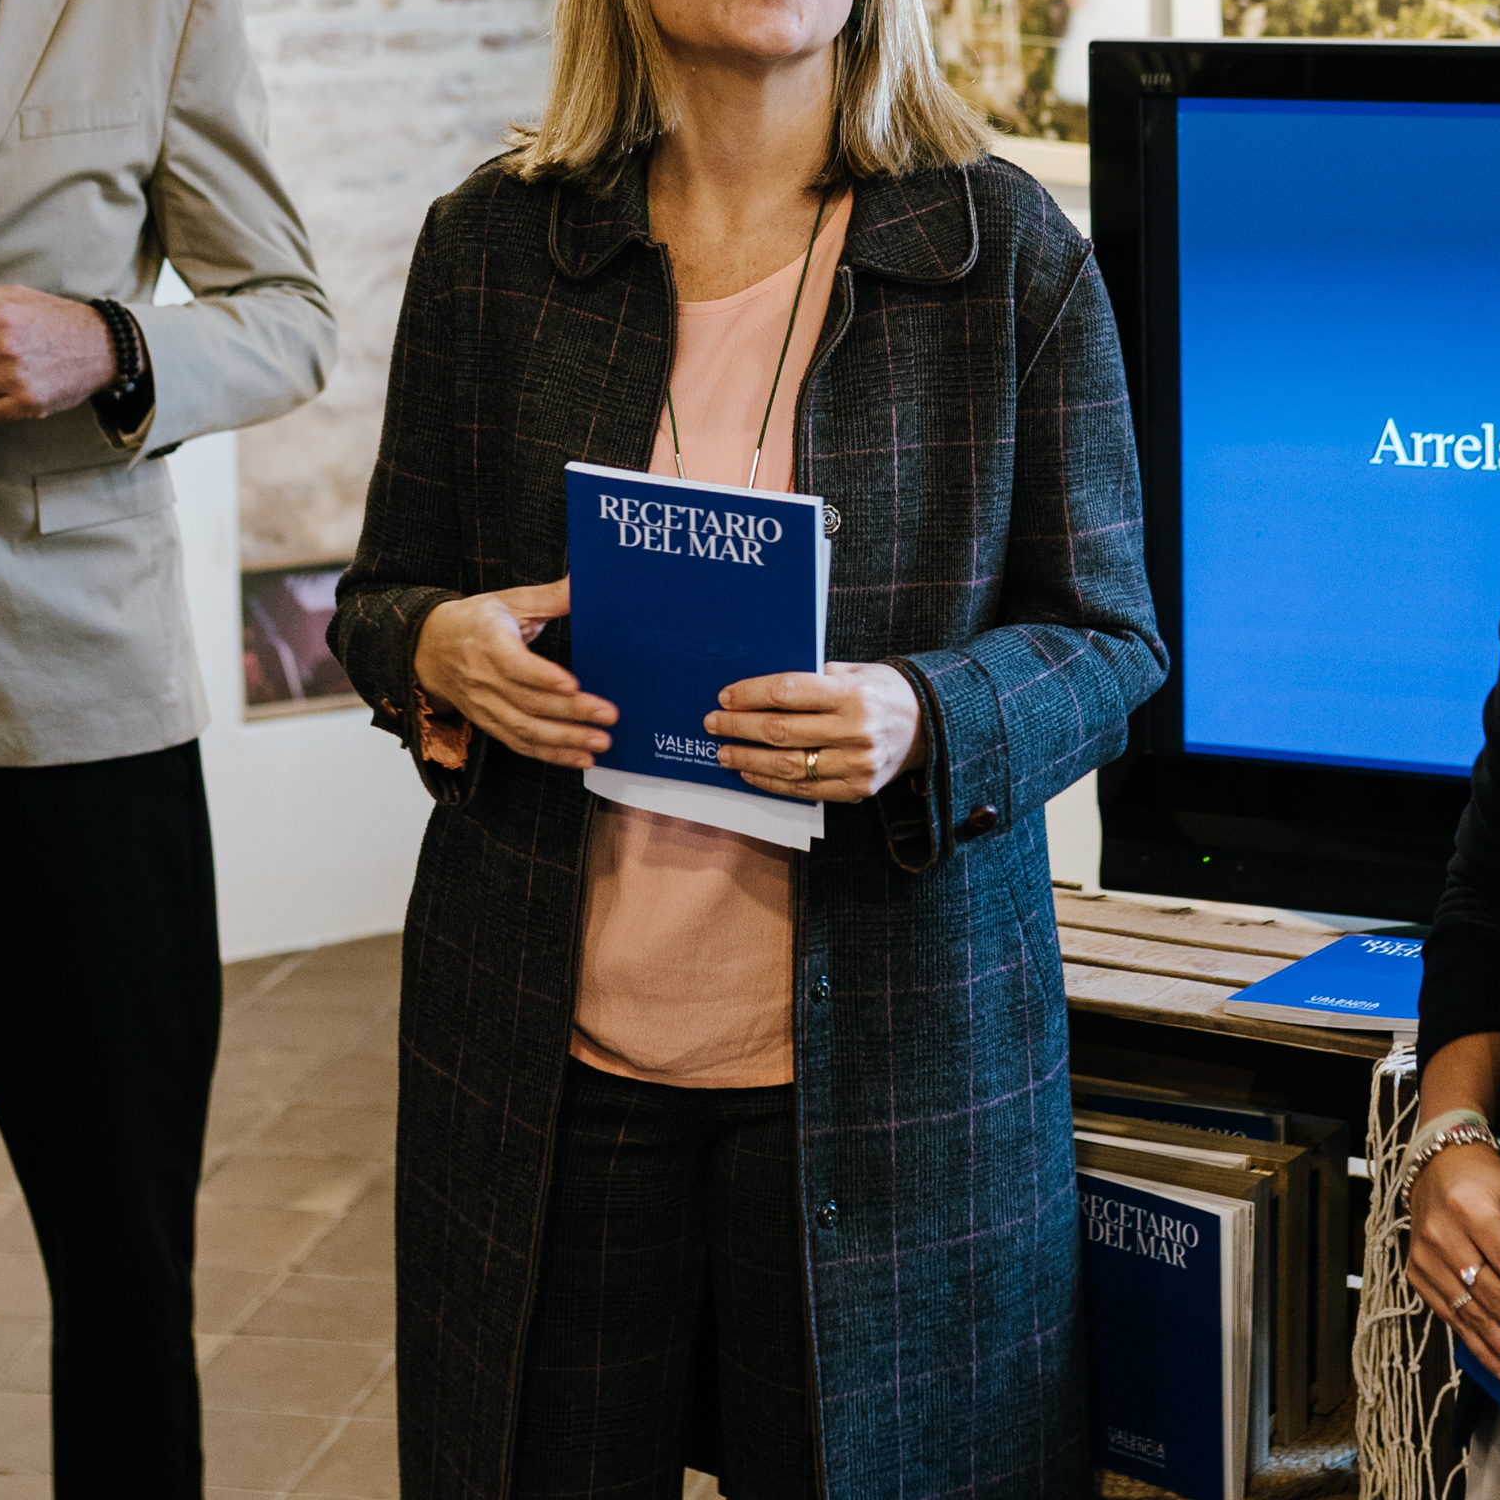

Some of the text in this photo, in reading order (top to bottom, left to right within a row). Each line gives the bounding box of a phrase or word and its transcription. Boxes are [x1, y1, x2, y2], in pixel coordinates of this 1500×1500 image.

[599, 494, 783, 543] RECETARIO
[618, 522, 765, 566] DEL MAR
[655, 733, 721, 759] VALENC
[1310, 995, 1380, 1009] VALENCIA
[1078, 1190, 1199, 1248] RECETARIO
[1089, 1218, 1188, 1269] DEL MAR
